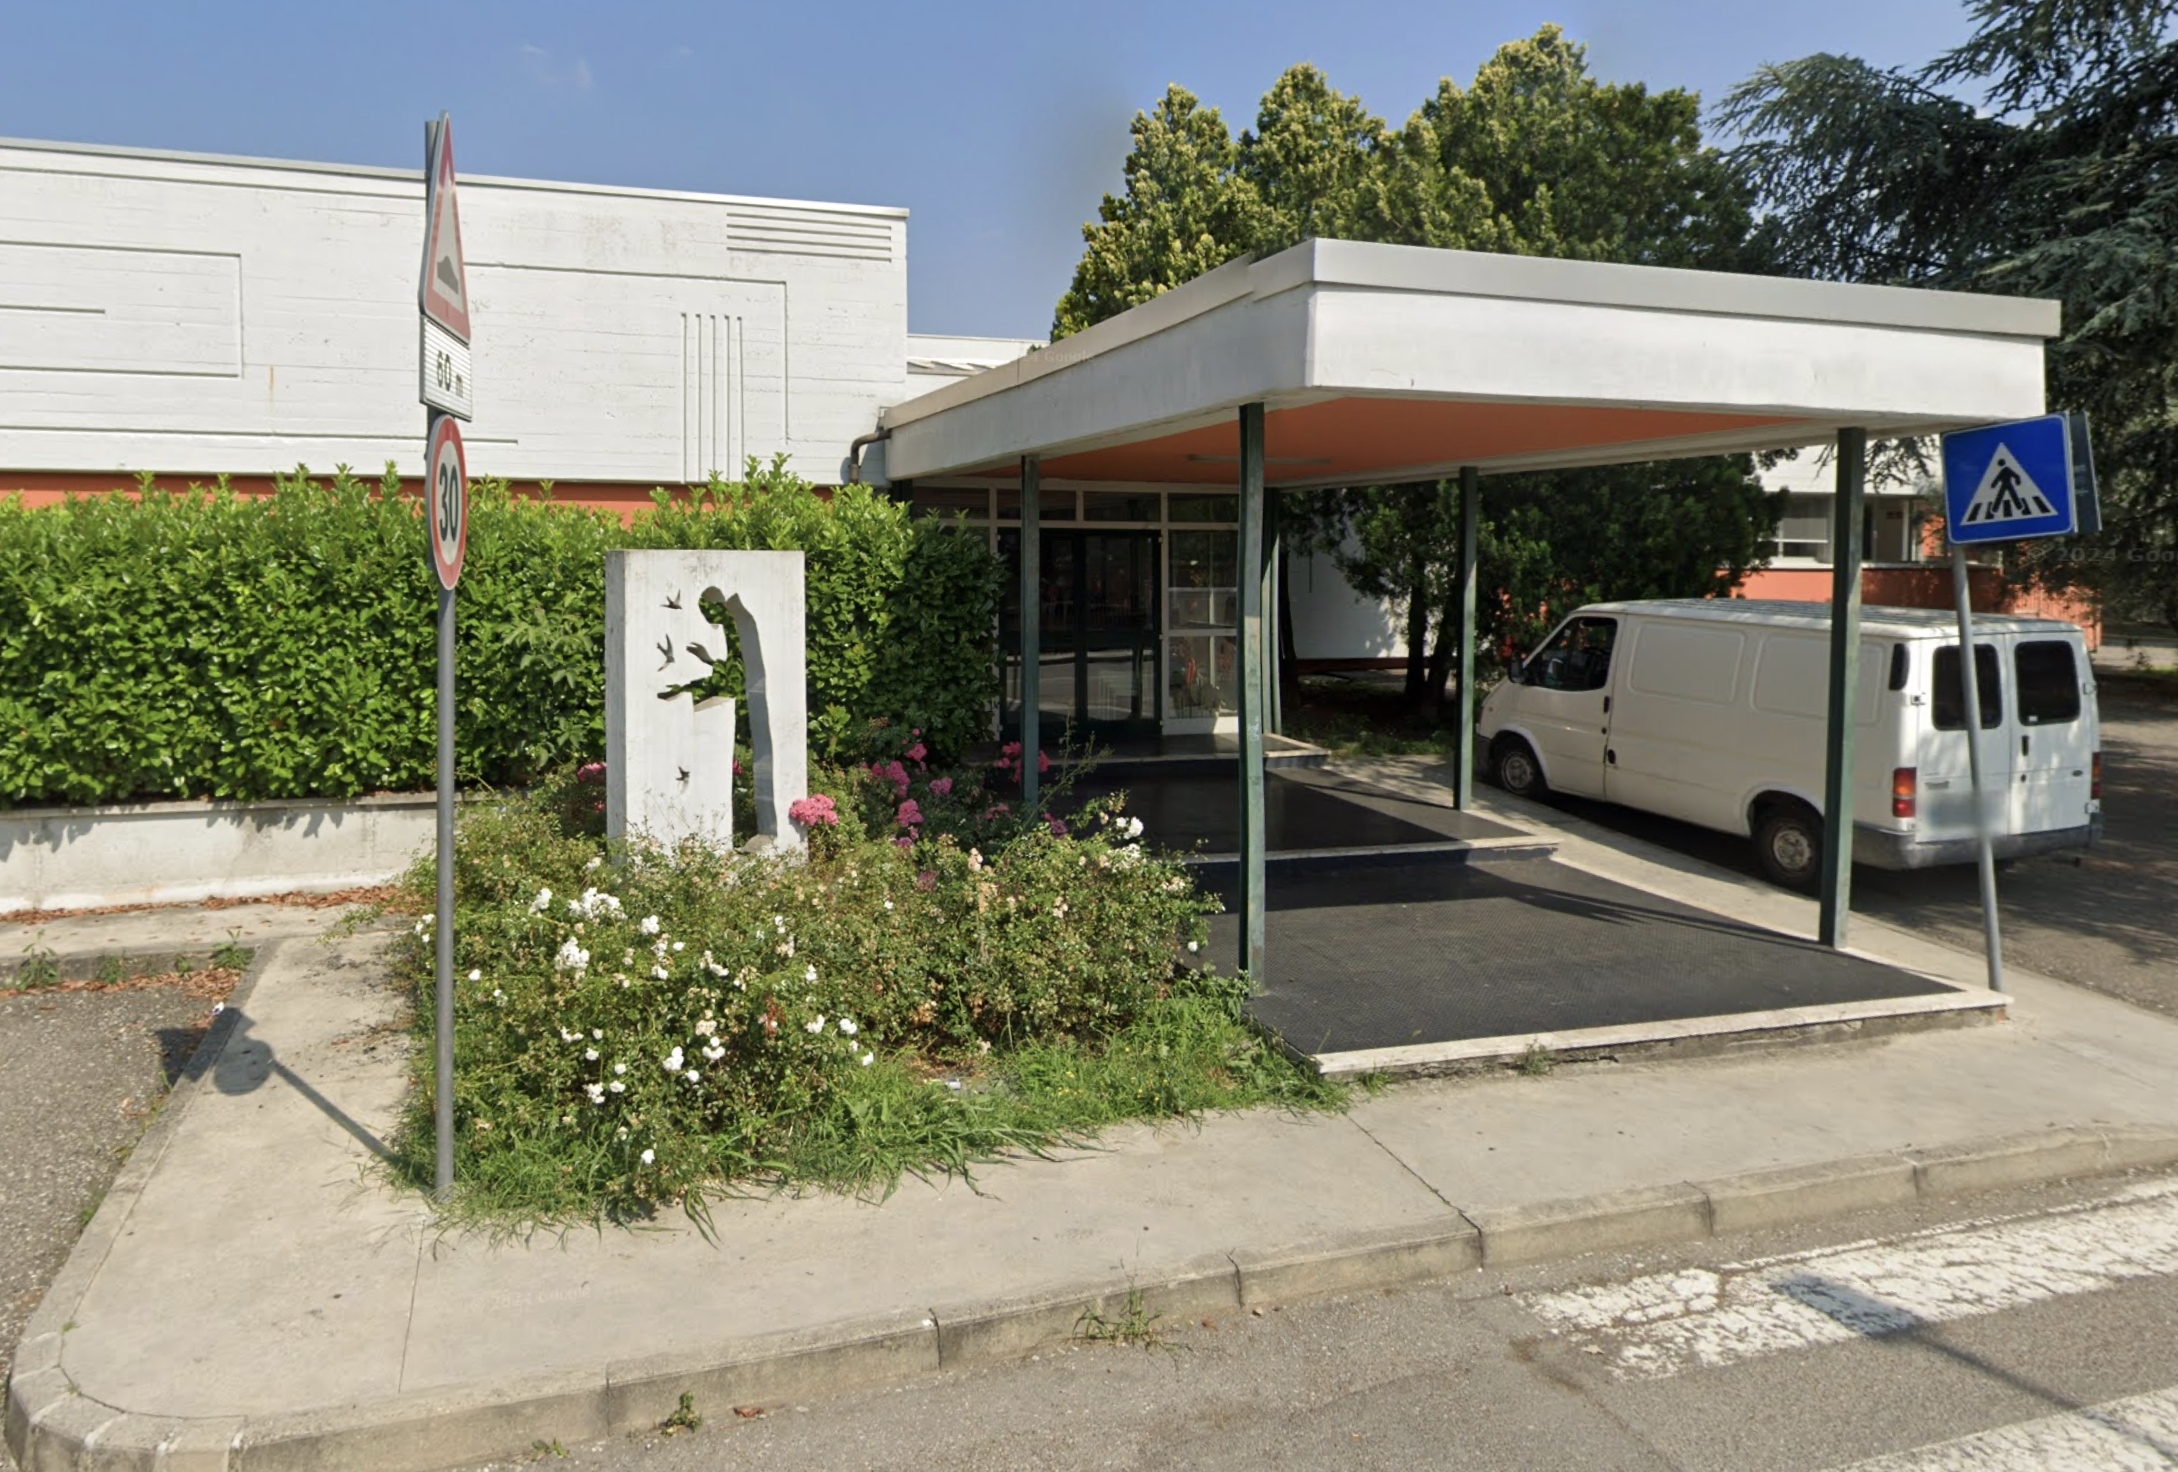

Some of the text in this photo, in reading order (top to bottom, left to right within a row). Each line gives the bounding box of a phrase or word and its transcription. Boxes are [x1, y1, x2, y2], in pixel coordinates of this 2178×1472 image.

[437, 349, 464, 398] 60 m
[439, 462, 459, 543] 30
